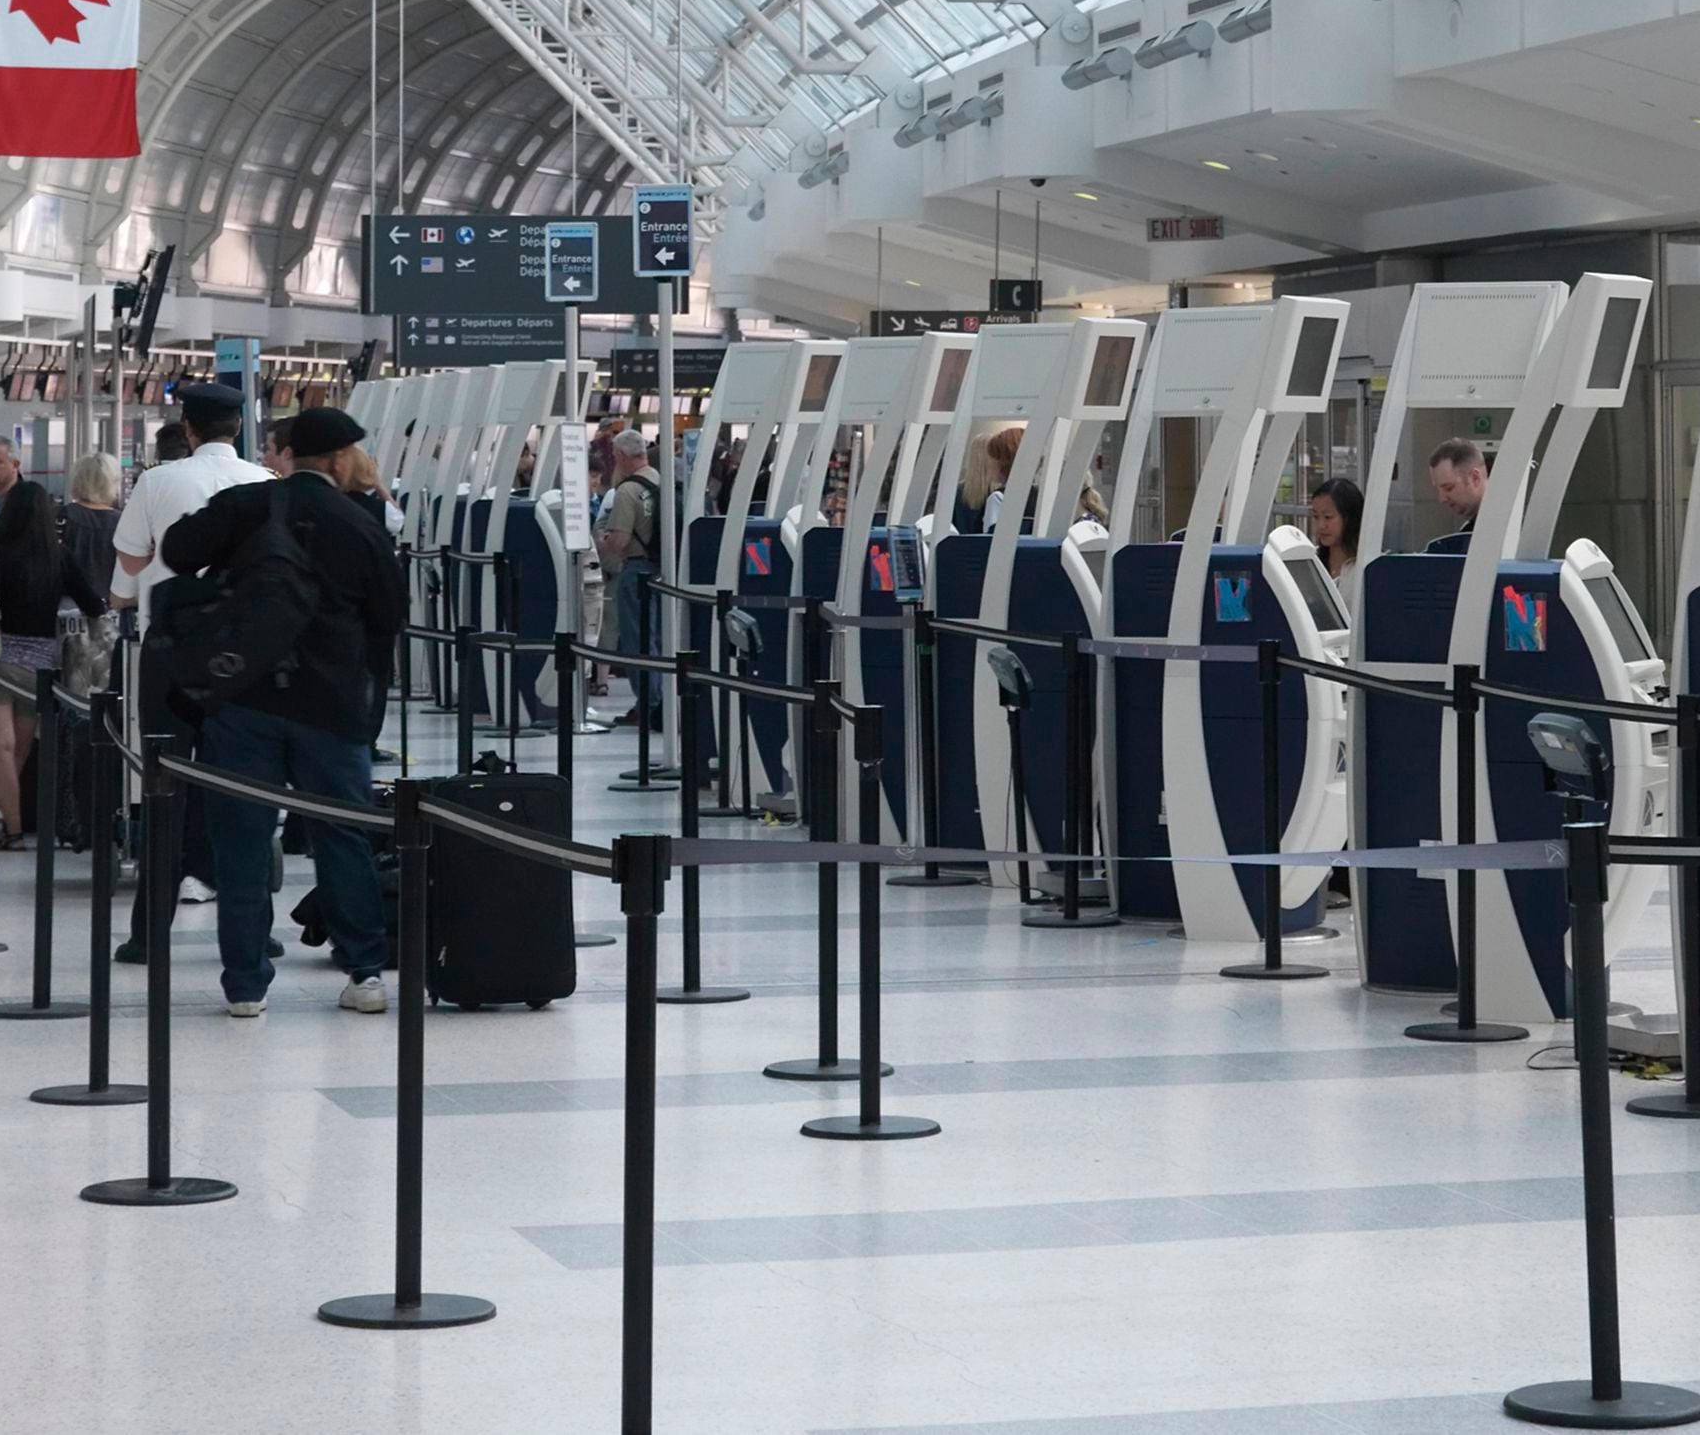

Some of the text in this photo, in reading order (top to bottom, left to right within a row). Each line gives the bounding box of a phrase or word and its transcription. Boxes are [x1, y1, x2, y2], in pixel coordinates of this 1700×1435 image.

[641, 222, 688, 232] Entrance
[1152, 219, 1181, 239] EXIT
[653, 233, 688, 243] Entrée
[552, 254, 592, 264] Entrance
[562, 263, 592, 273] Entrée
[461, 317, 554, 328] Departures Départs
[985, 315, 1021, 324] Arrivals
